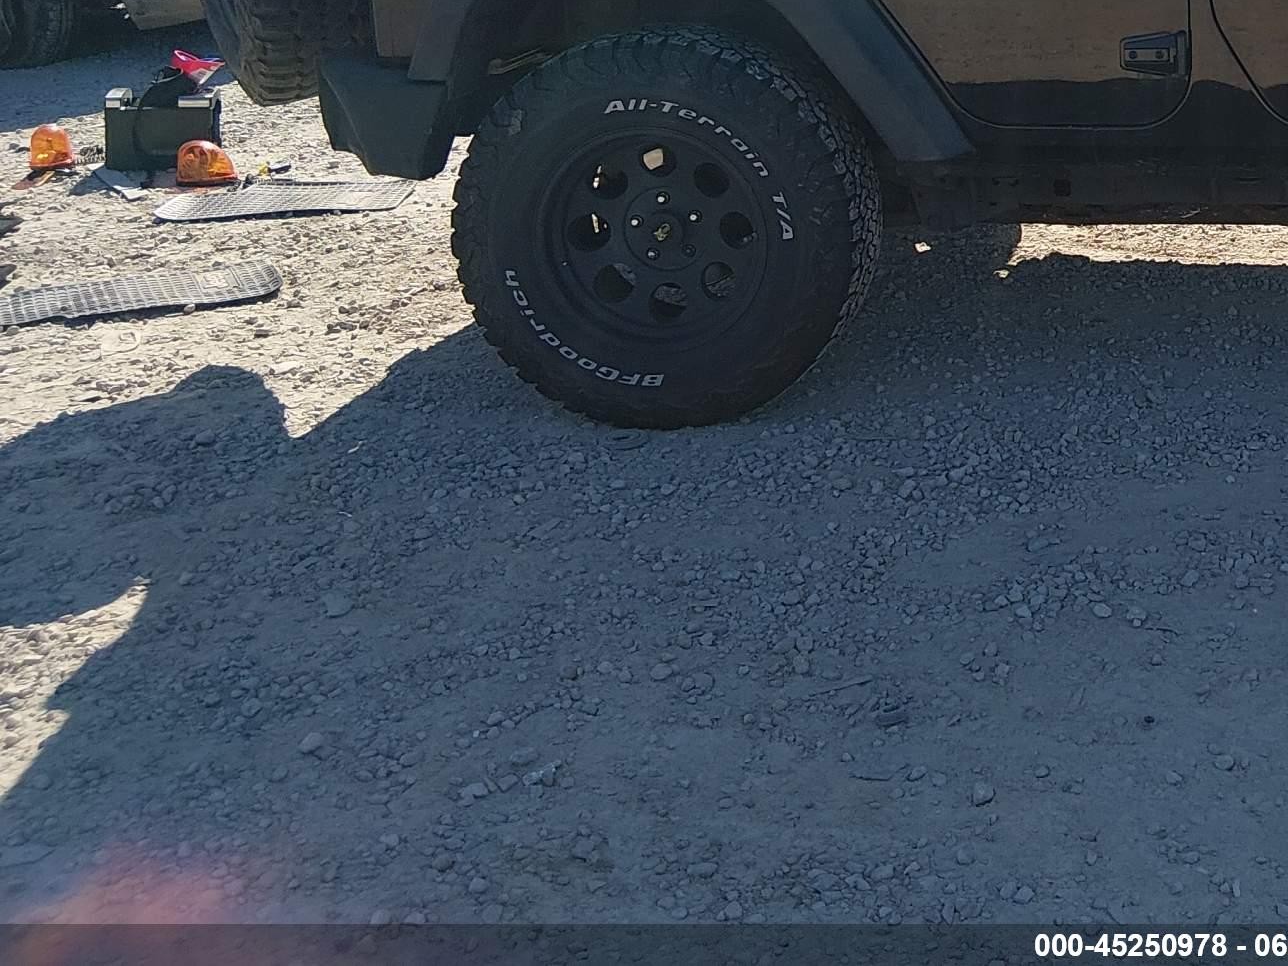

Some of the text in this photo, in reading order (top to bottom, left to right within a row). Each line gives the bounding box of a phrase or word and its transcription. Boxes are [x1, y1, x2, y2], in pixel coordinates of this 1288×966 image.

[604, 98, 794, 241] All-Terrain T/A
[505, 270, 664, 387] BFGoodrich
